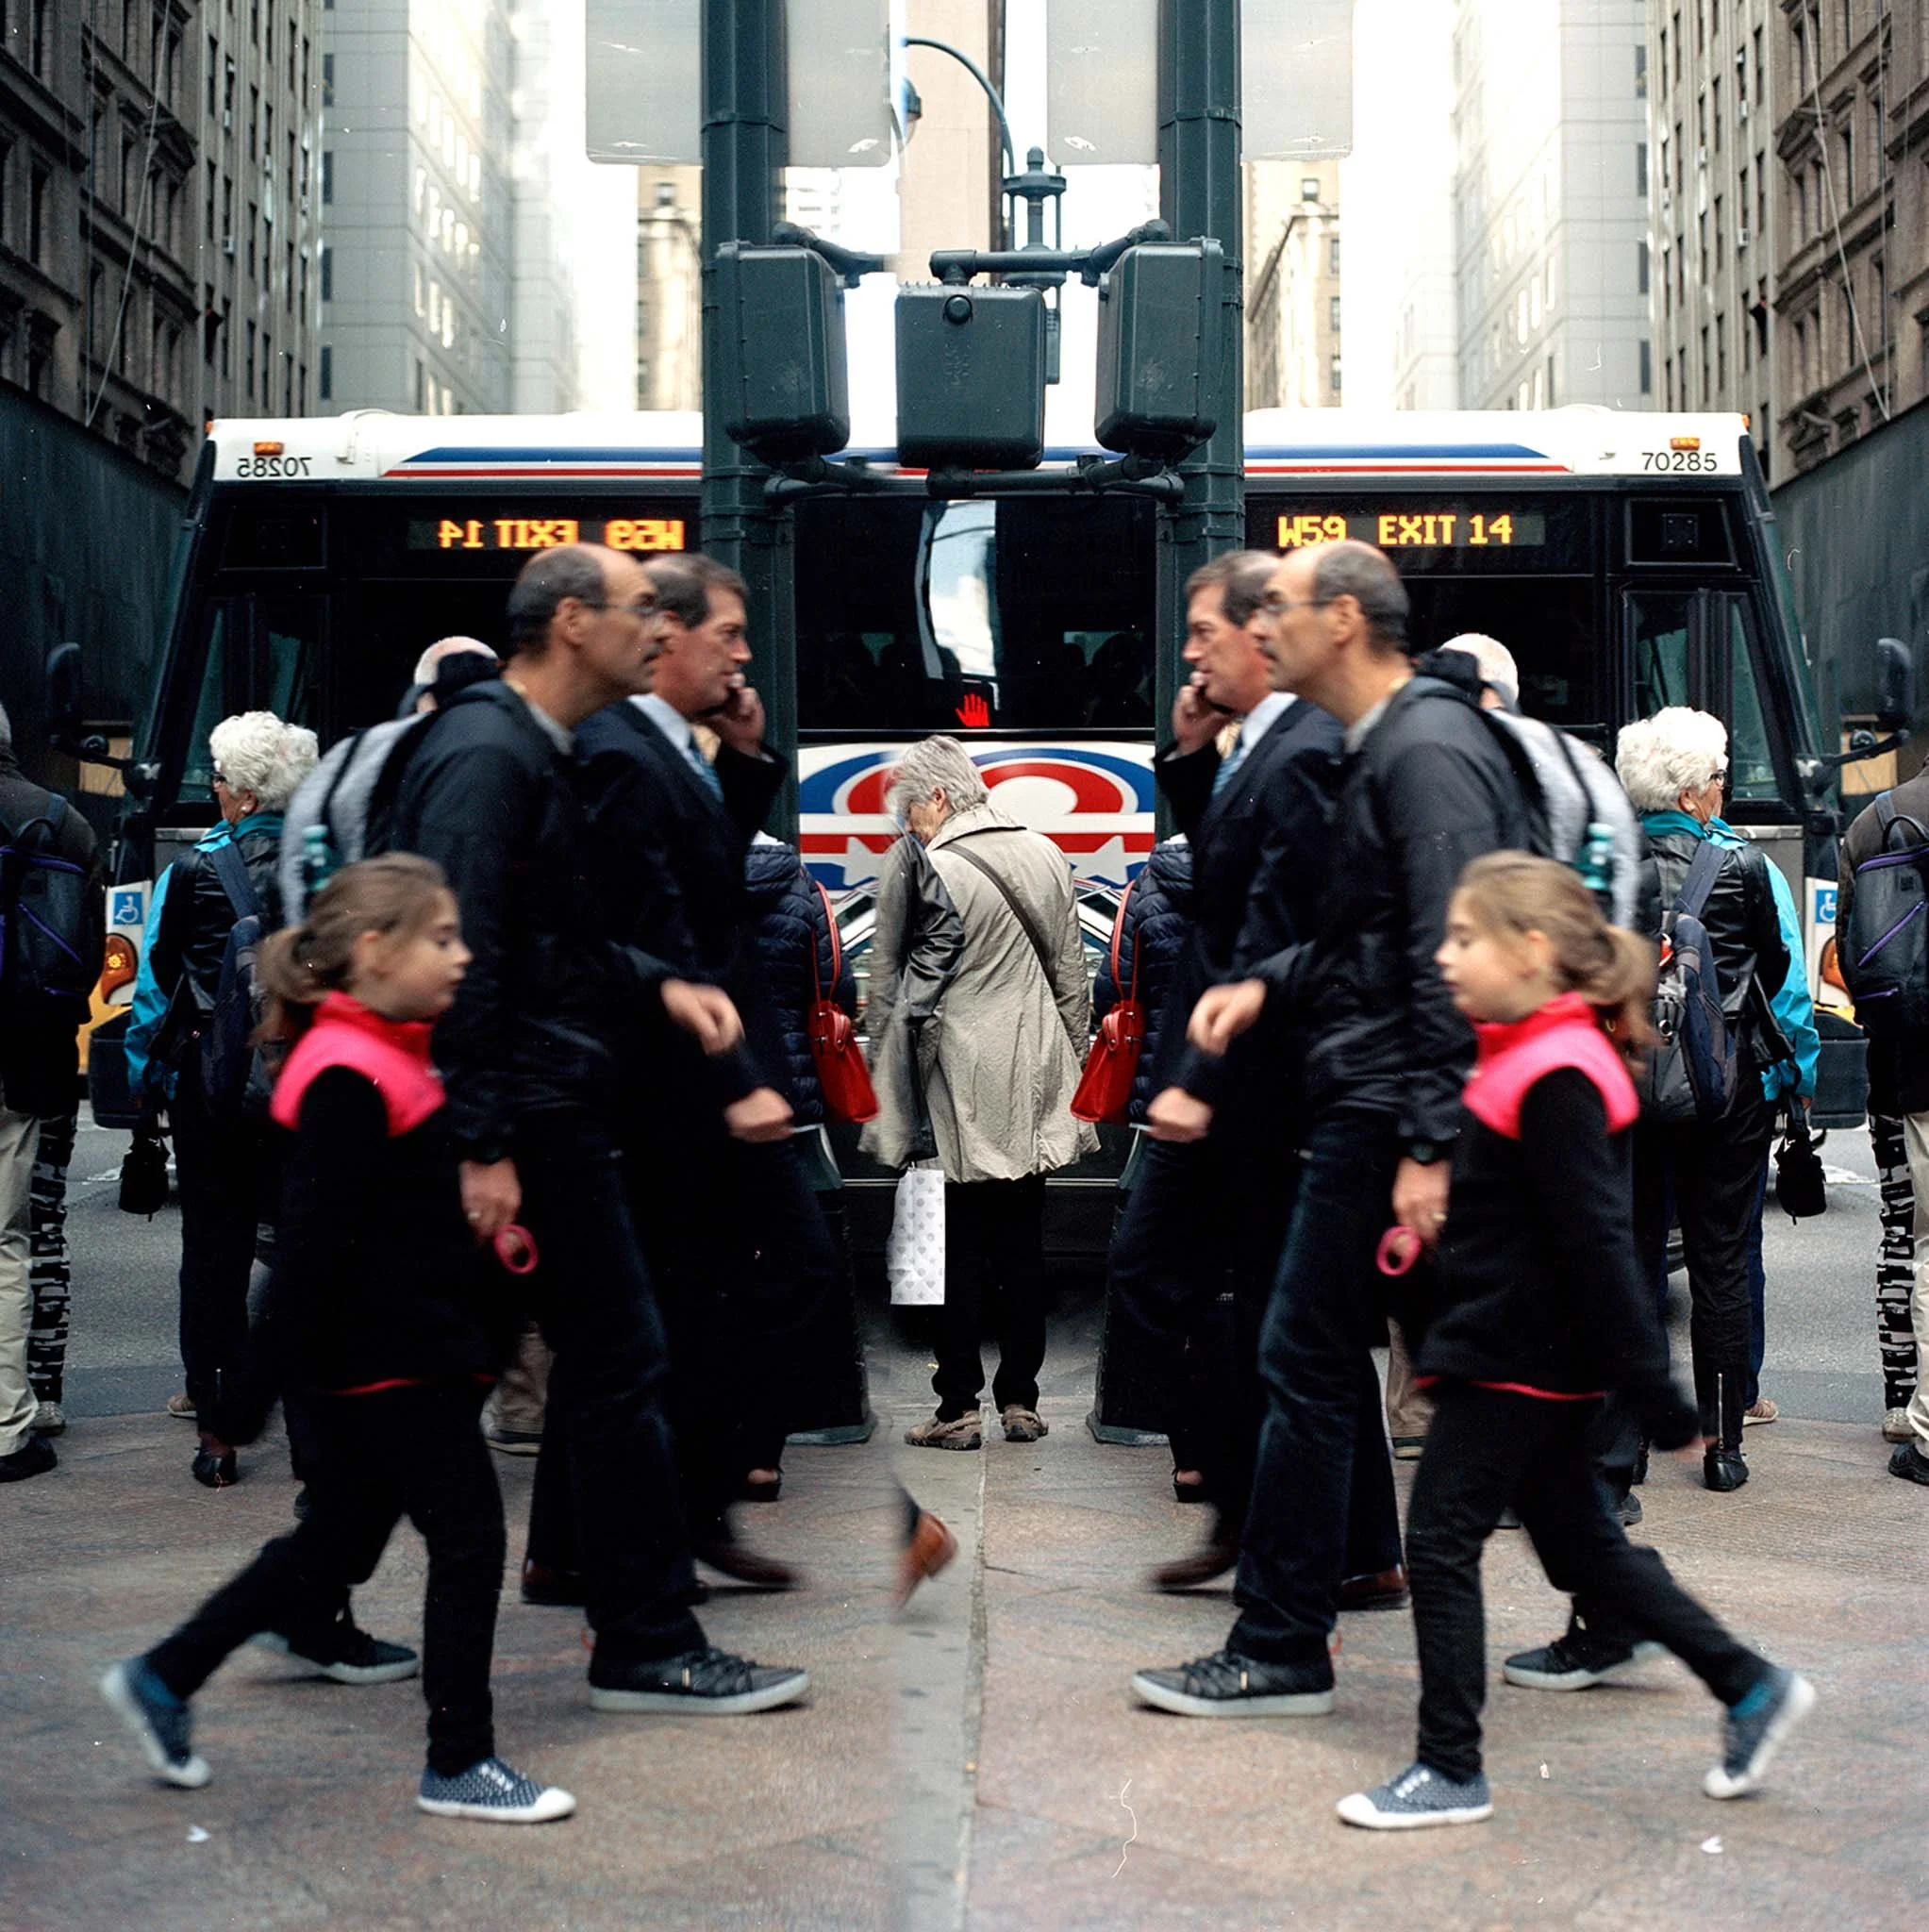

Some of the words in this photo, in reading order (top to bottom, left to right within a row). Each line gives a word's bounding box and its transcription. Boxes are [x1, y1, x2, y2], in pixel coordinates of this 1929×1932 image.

[1641, 452, 1718, 472] 70285
[1277, 516, 1347, 548] W59
[1378, 515, 1456, 545] EXIT
[1469, 515, 1513, 544] 14
